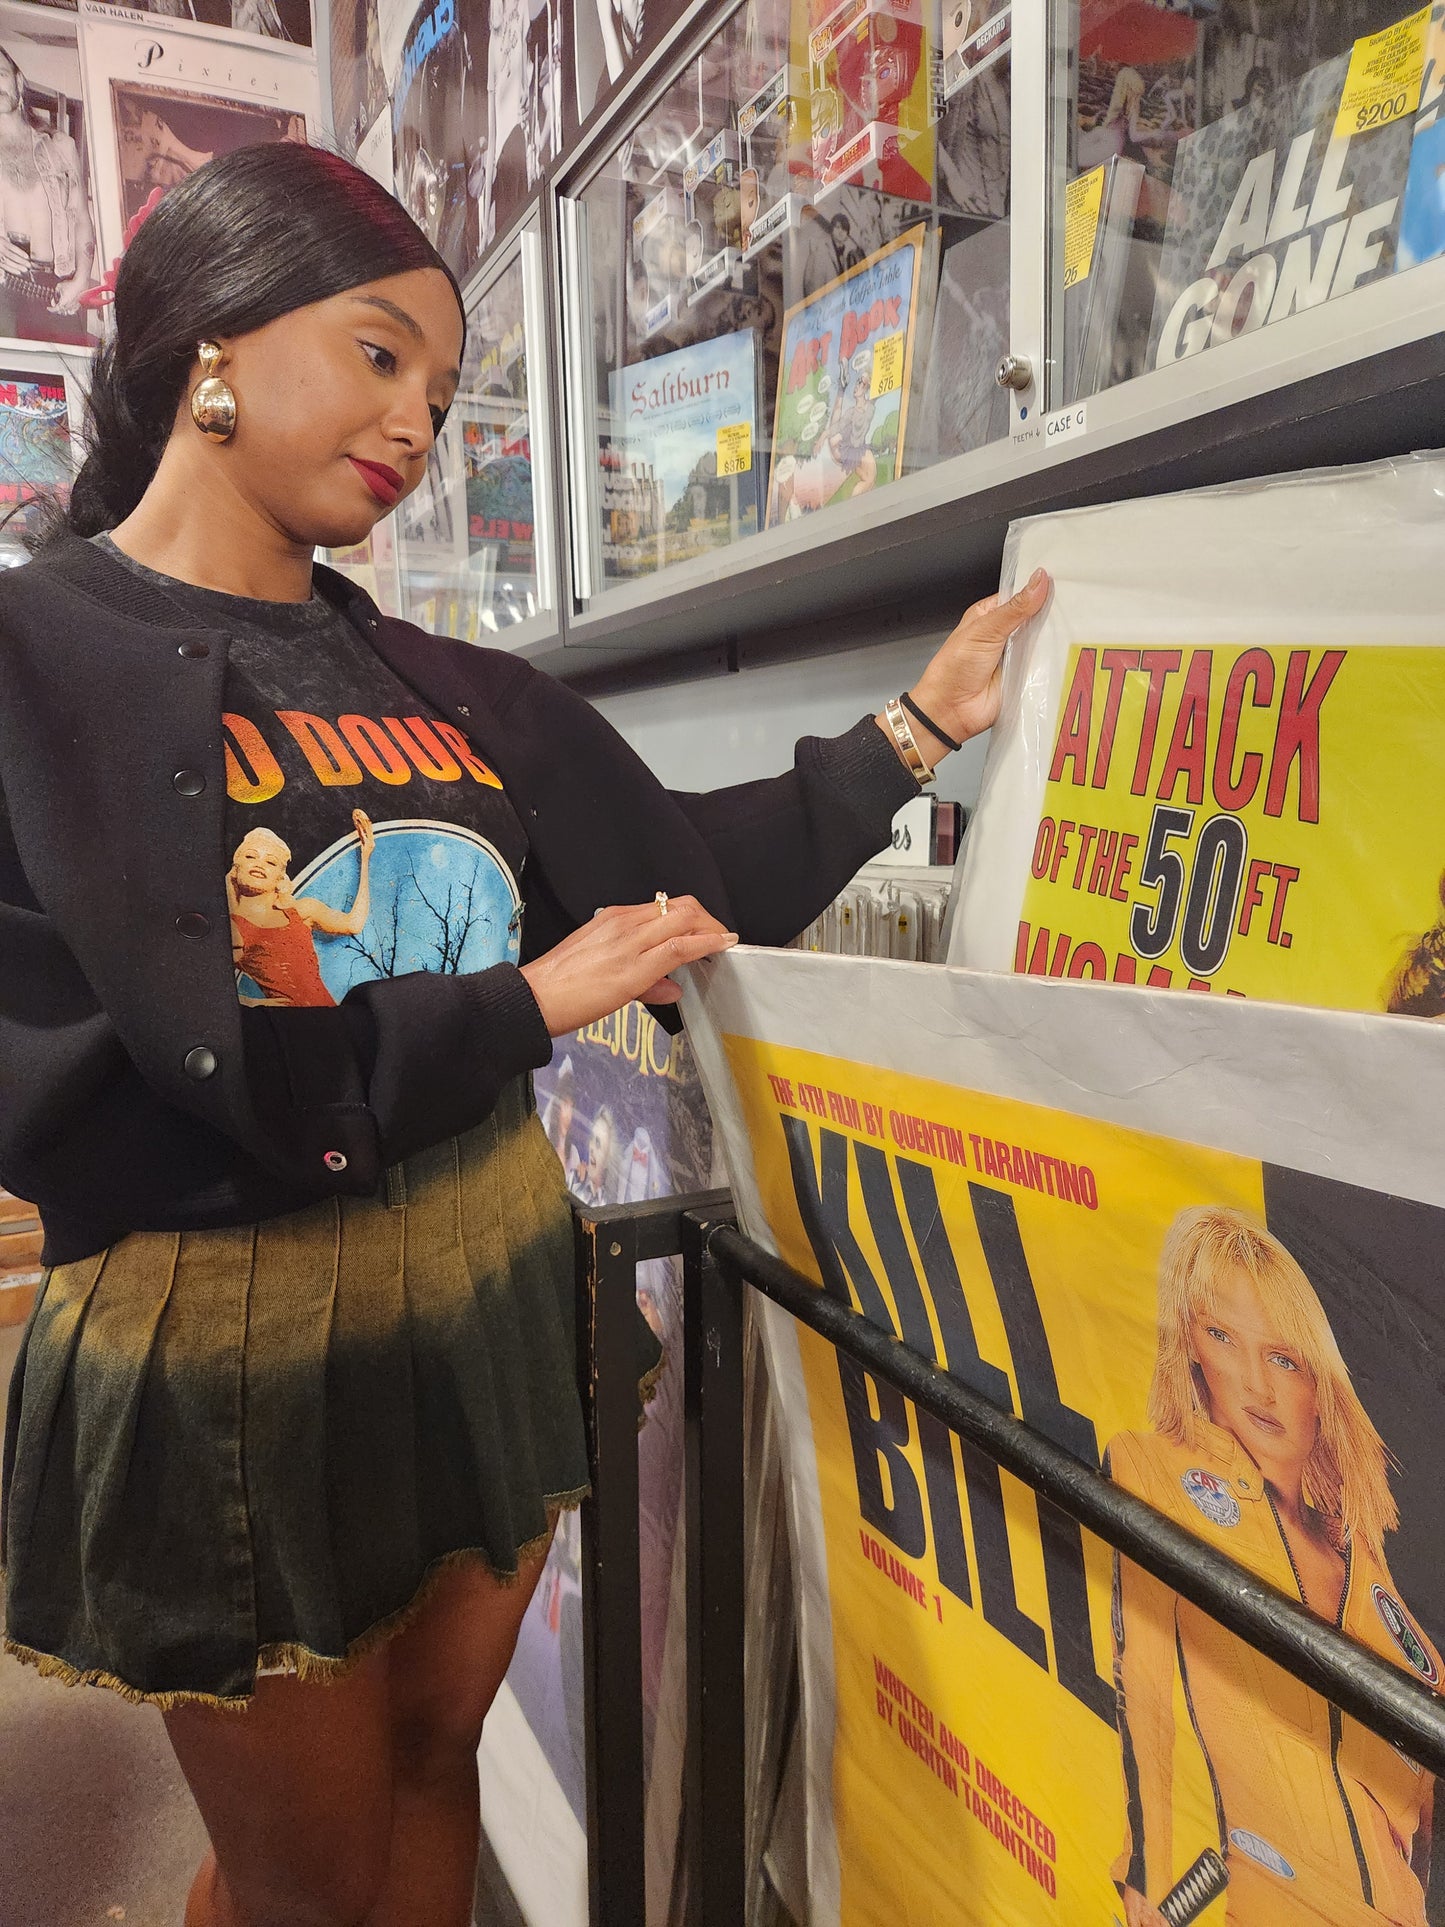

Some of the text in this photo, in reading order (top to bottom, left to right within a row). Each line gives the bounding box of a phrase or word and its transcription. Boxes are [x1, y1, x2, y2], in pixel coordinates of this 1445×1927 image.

[85, 4, 144, 22] VAN HALEN
[976, 18, 1005, 50] DECKARD
[134, 38, 280, 92] Pixies
[1355, 92, 1407, 130] $200
[1205, 127, 1354, 272] ALL
[1155, 196, 1399, 370] GONE
[786, 330, 833, 396] ART
[839, 294, 903, 362] BOOK
[38, 385, 66, 401] THE
[629, 364, 731, 424] Saltburn
[878, 374, 894, 395] $75
[1047, 410, 1084, 436] CASE G
[723, 456, 746, 474] $375
[1012, 430, 1034, 446] TEETH
[1048, 647, 1348, 824] ATTACK
[1031, 816, 1076, 883] OF
[1073, 825, 1140, 903] THE
[1129, 804, 1248, 978] 50
[1237, 858, 1300, 949] FT.
[767, 1073, 1099, 1211] THE 4TH FILM BY QUENTIN TARANTINO
[779, 1112, 1102, 1470] KILL
[1190, 1472, 1220, 1492] CAT
[835, 1345, 1120, 1734] BILL
[859, 1528, 943, 1625] VOLUME 1
[873, 1653, 1056, 1864] WRITTEN AND DIRECTED
[876, 1686, 1056, 1900] BY QUENTIN TARANTINO
